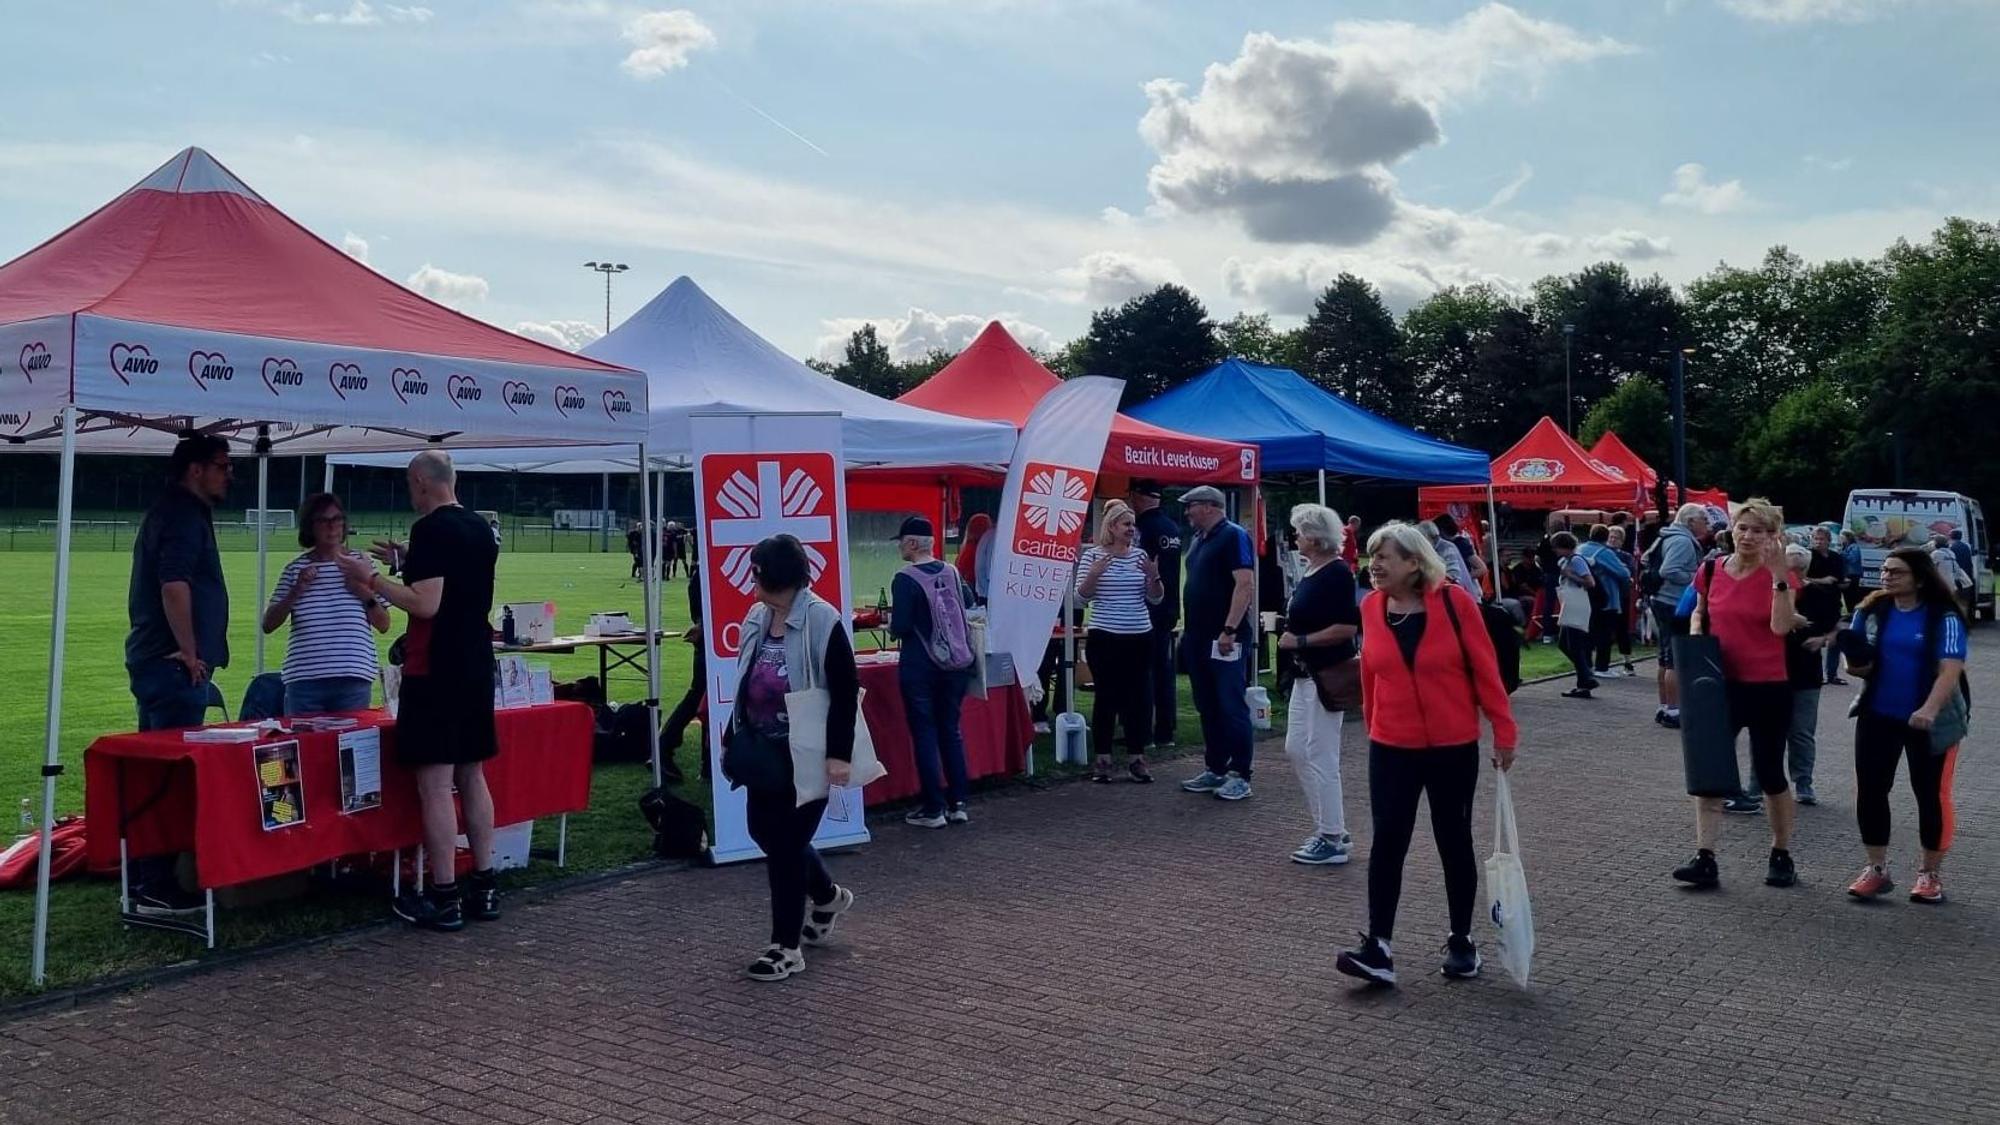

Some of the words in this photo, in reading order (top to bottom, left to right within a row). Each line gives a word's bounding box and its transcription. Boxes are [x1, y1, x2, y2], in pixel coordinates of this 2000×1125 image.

[27, 353, 51, 370] AWO
[122, 356, 159, 375] AWO
[200, 363, 234, 381] AWO
[272, 369, 303, 386] AWO
[339, 375, 368, 391] AWO
[401, 380, 428, 396] AWO
[456, 385, 482, 401] AWO
[510, 390, 535, 406] AWO
[562, 395, 585, 410] AWO
[610, 399, 632, 413] AWO
[1124, 445, 1159, 466] Bezirk
[1161, 449, 1219, 471] Leverkusen
[1470, 486, 1500, 494] BAYR
[1018, 539, 1076, 561] caritas
[1006, 581, 1064, 602] KUSE
